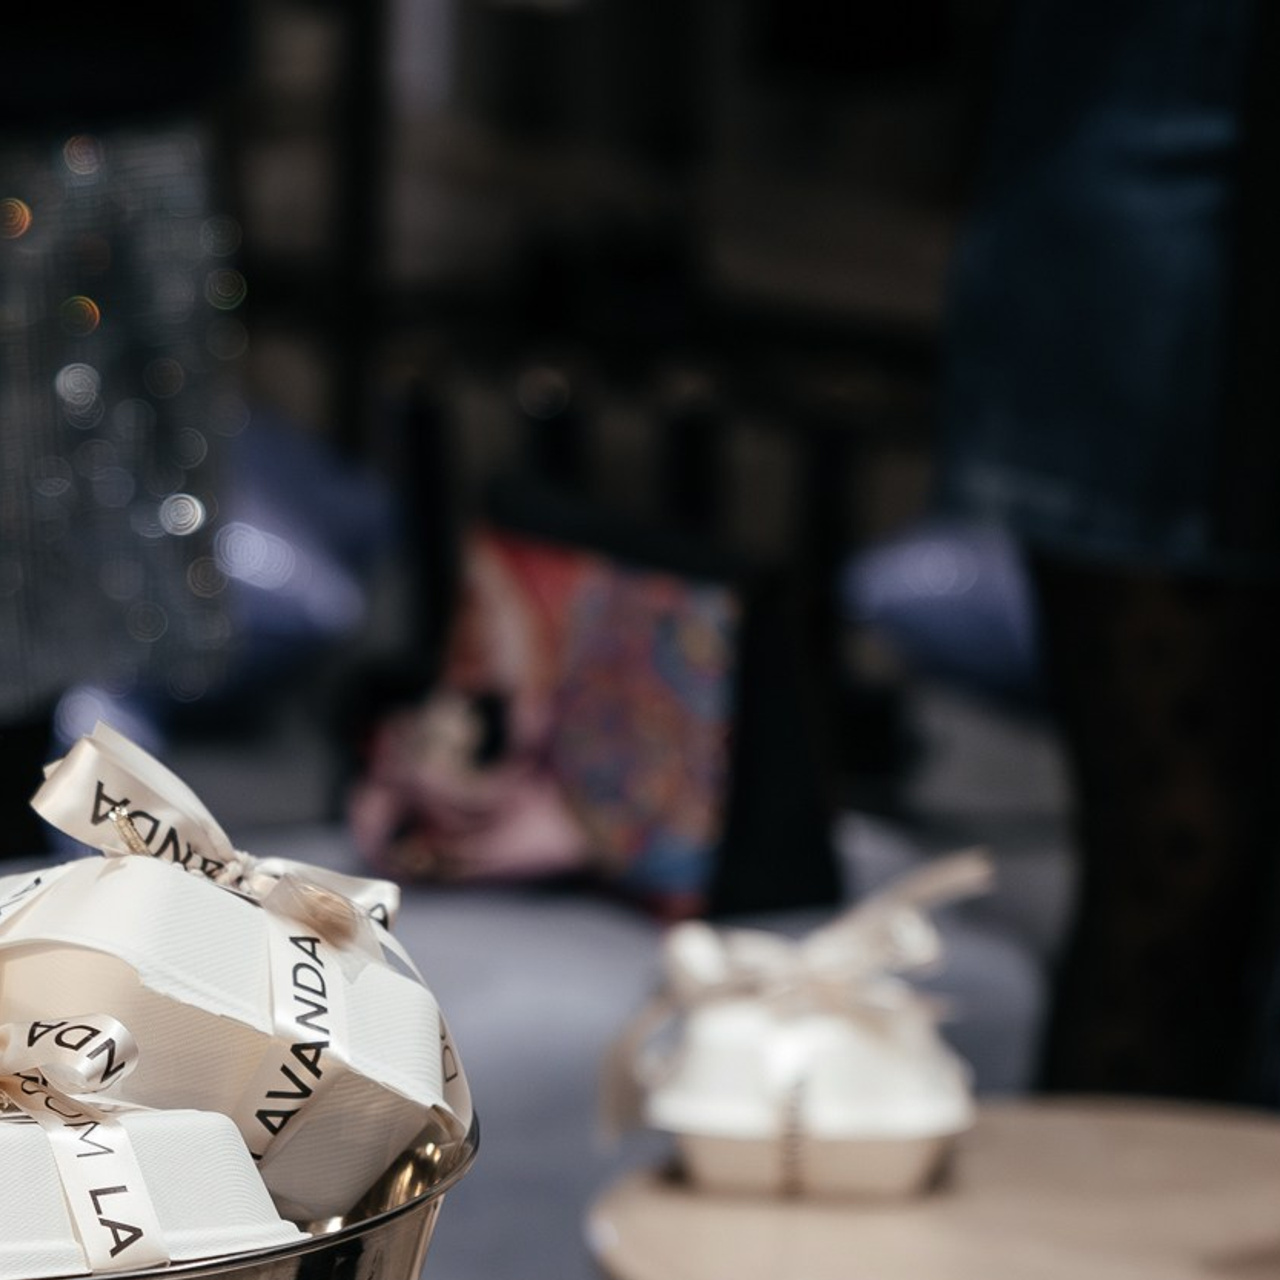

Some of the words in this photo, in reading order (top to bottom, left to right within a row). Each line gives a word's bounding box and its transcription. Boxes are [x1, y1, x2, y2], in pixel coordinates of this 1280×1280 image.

[27, 1020, 126, 1084] NDA
[249, 936, 331, 1161] AVANDA
[88, 1184, 145, 1258] LA
